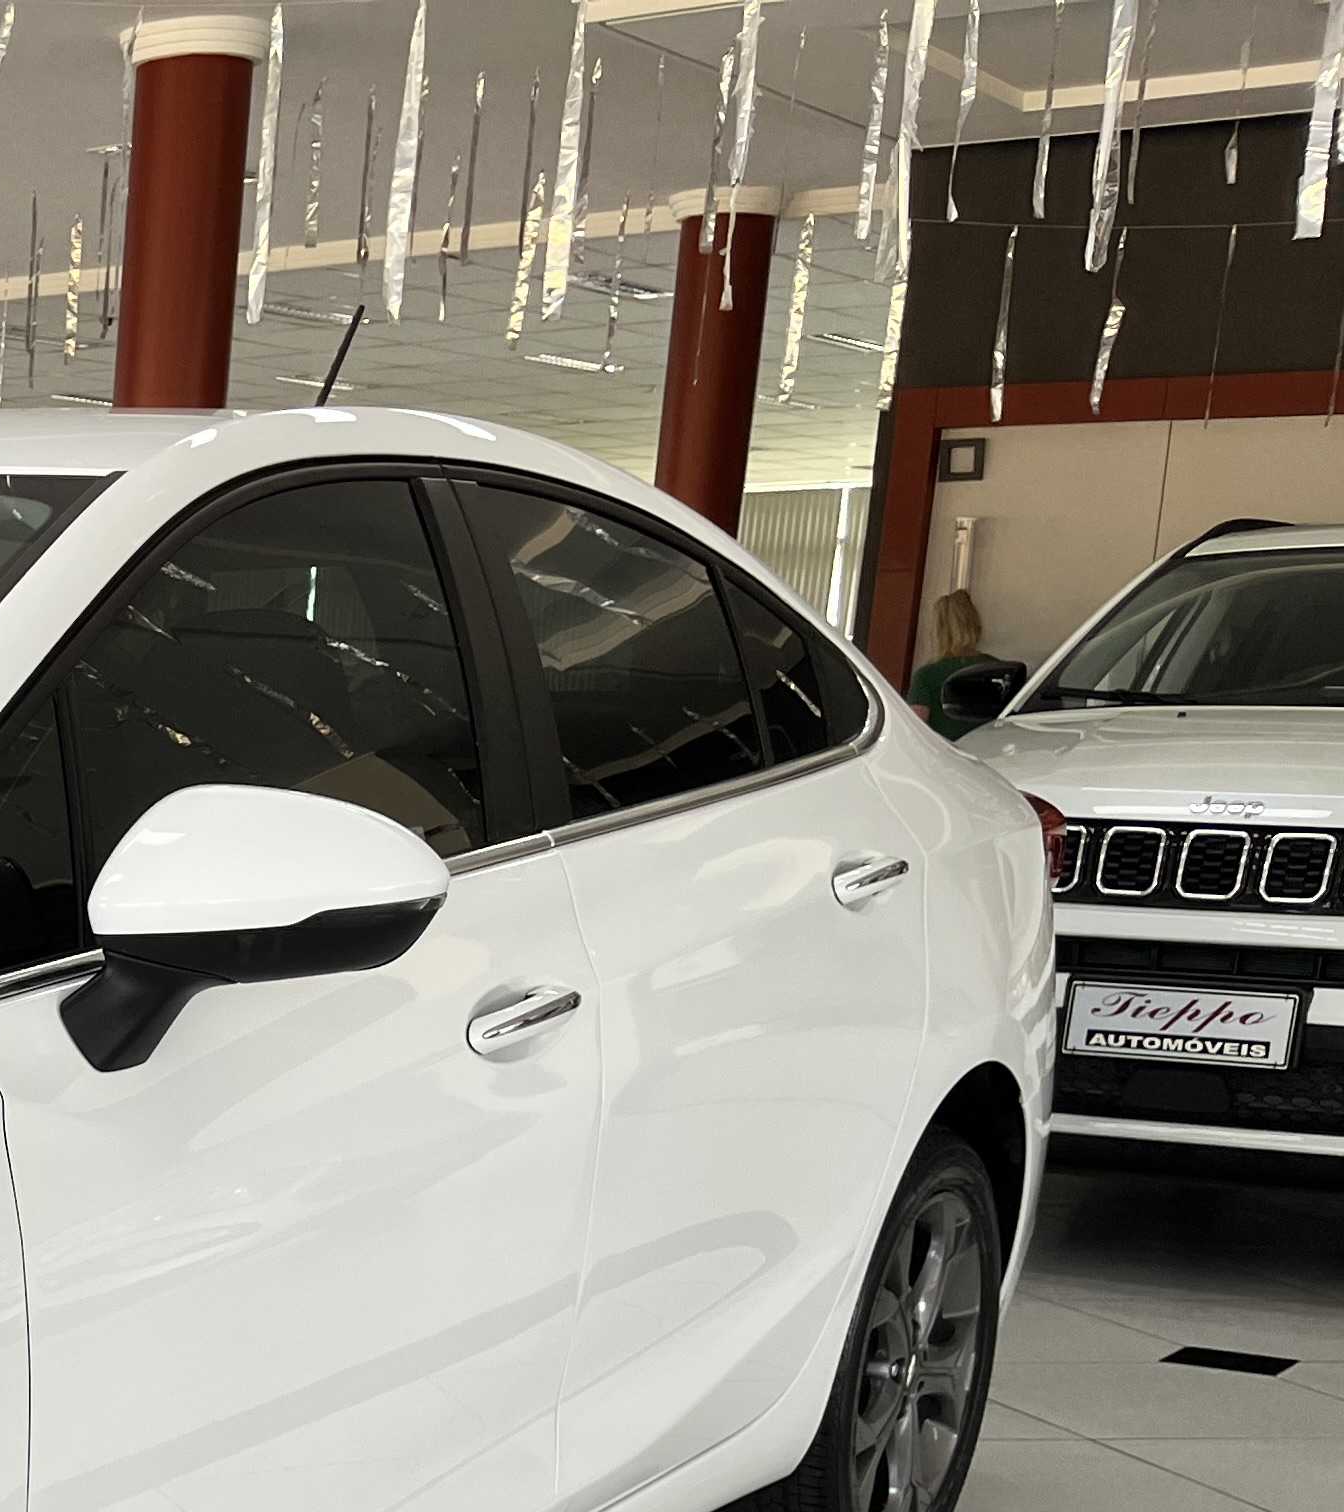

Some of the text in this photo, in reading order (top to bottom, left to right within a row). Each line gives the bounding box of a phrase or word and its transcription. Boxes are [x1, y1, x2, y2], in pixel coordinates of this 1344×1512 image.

[1190, 795, 1264, 819] Jeep
[1091, 991, 1276, 1033] Tieppo
[1088, 1032, 1267, 1058] AUTOMÓVEIS
